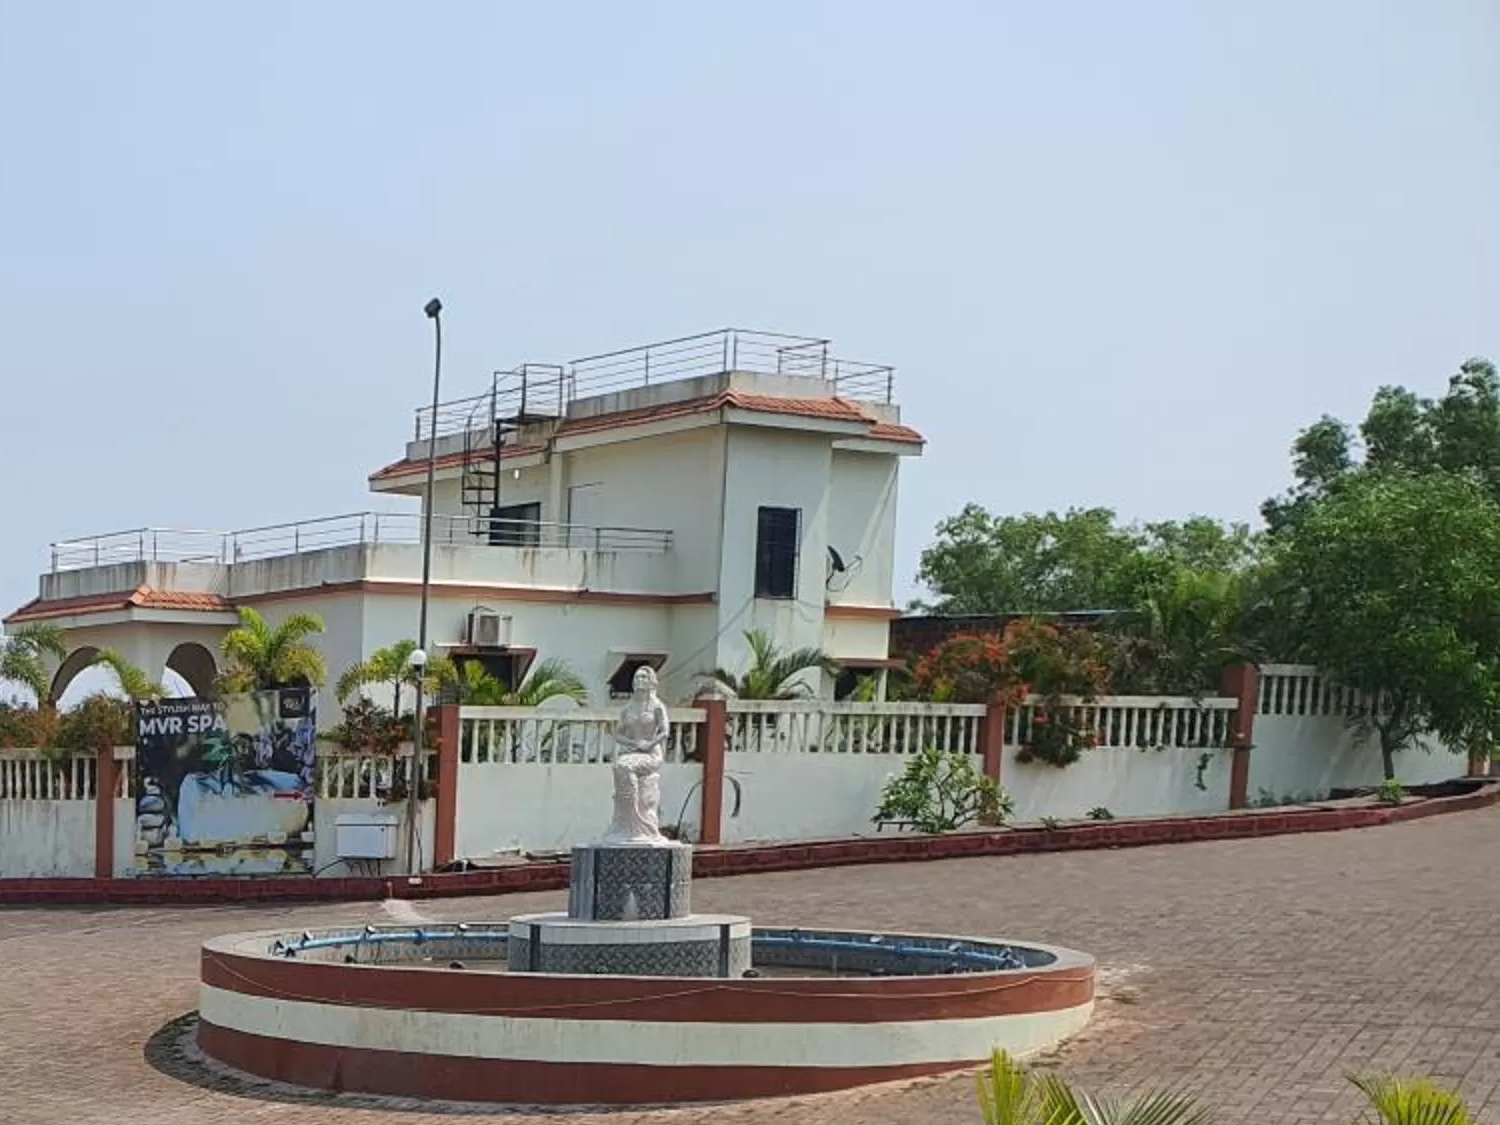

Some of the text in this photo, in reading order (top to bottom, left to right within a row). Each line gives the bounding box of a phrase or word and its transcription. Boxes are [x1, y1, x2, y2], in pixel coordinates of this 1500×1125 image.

[141, 707, 157, 715] THE
[140, 714, 228, 736] MVR SPA
